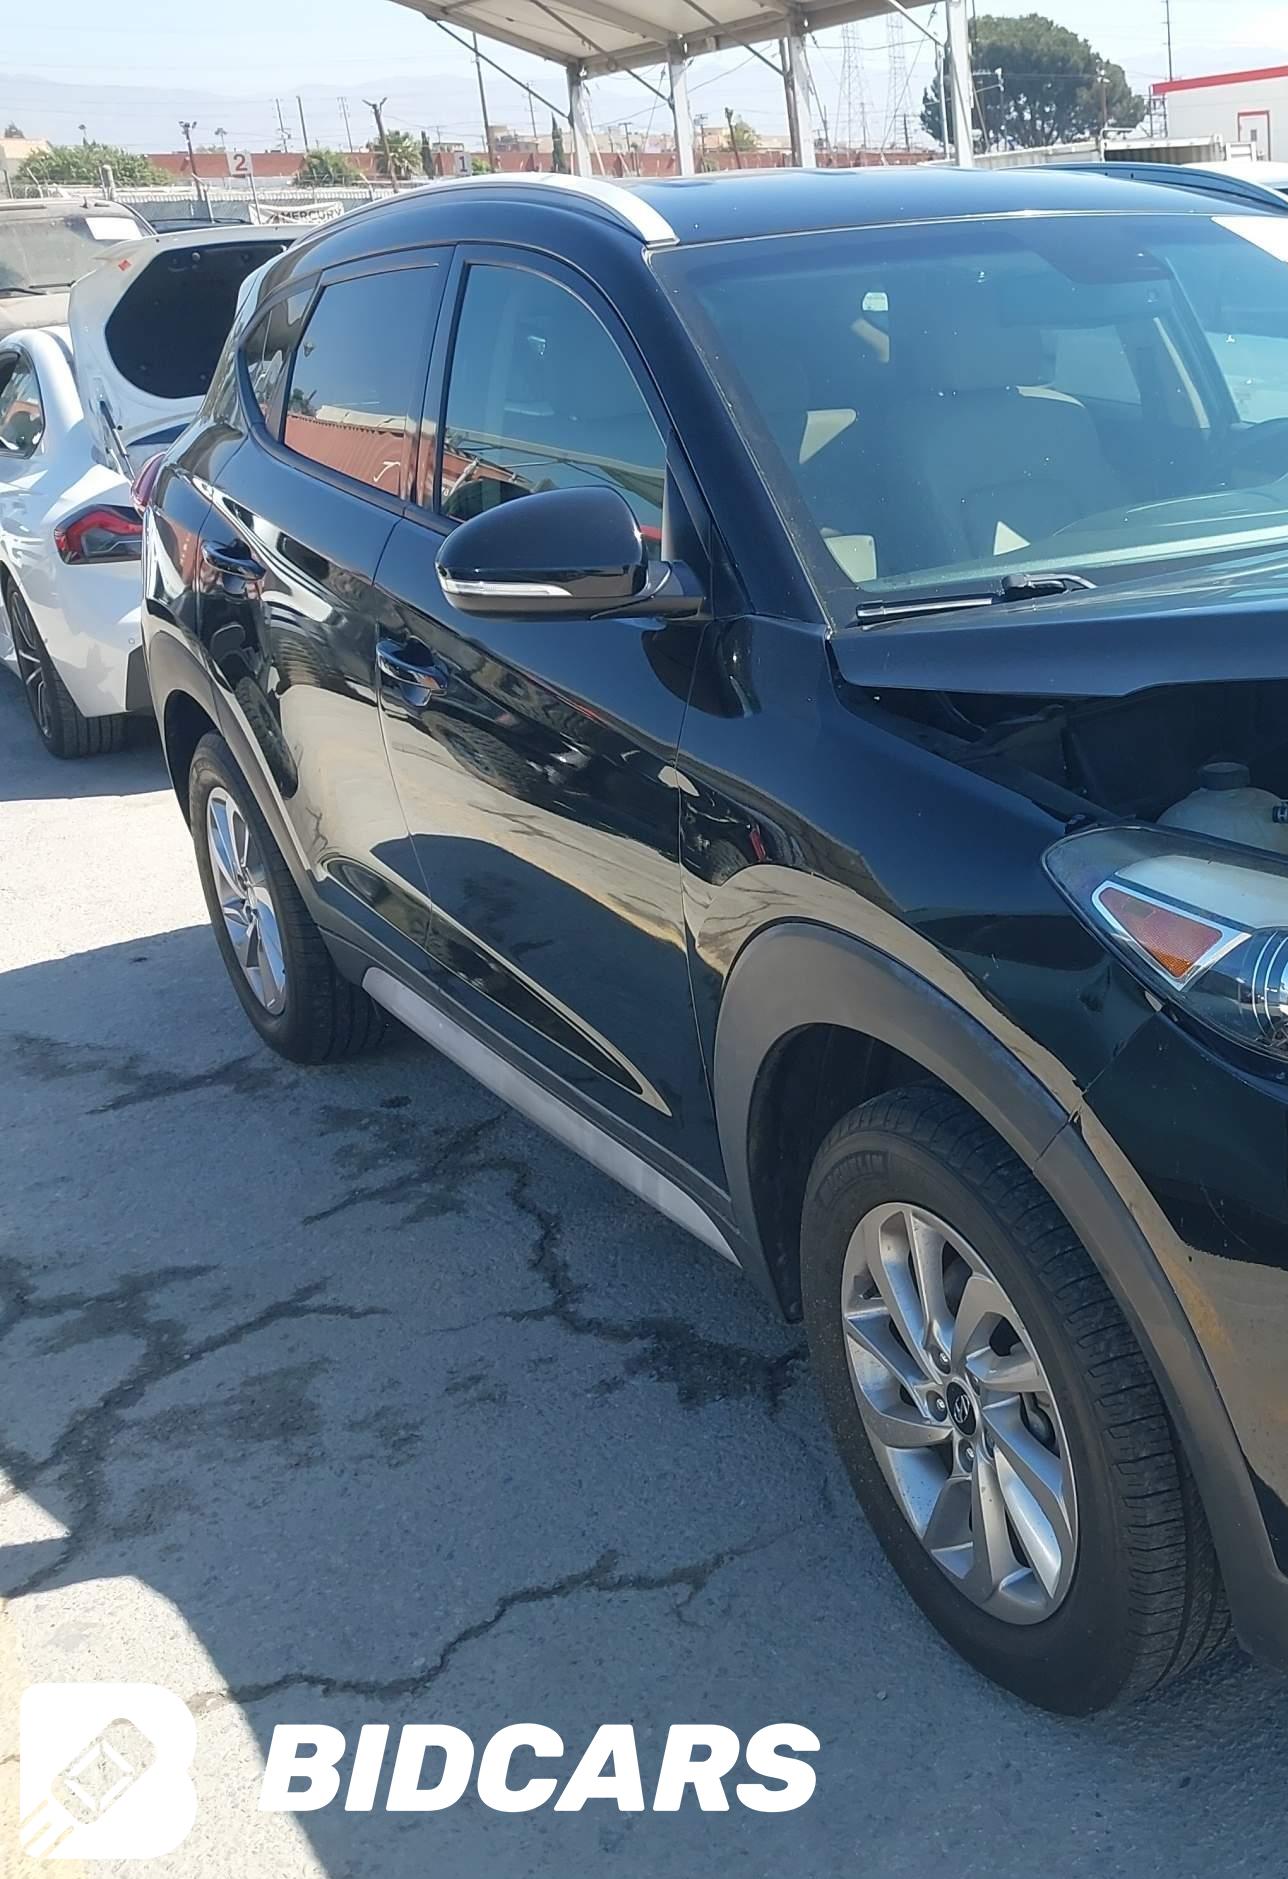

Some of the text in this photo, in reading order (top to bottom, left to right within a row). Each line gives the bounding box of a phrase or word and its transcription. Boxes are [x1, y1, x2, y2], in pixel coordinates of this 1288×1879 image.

[232, 153, 248, 172] 2
[459, 155, 468, 173] 1
[280, 207, 342, 220] MERCURY
